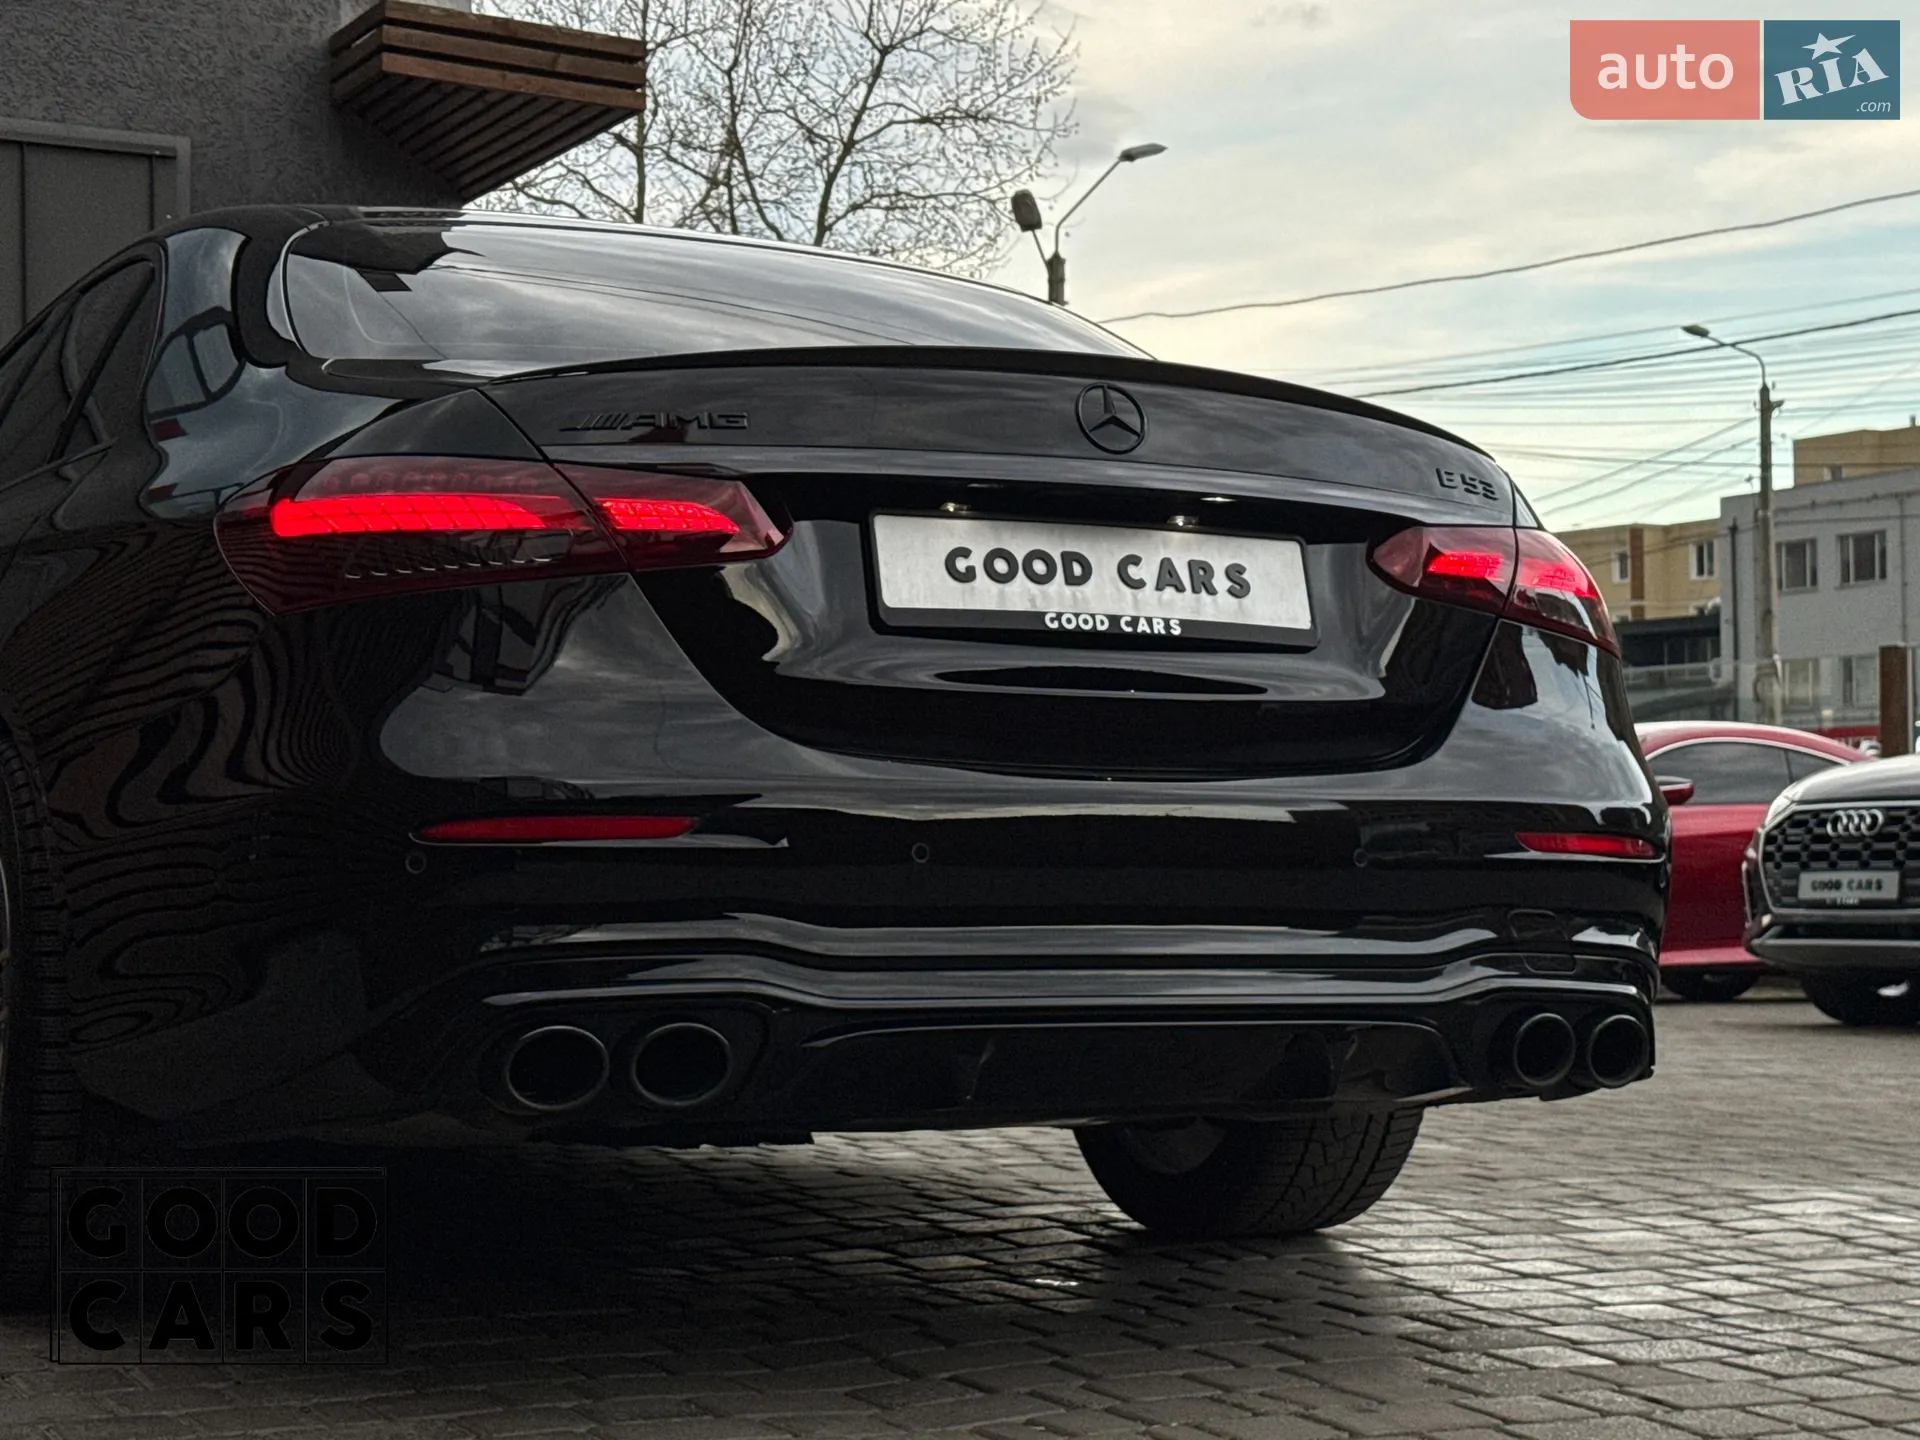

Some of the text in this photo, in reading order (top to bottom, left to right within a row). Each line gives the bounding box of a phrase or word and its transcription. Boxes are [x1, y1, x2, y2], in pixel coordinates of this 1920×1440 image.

[620, 411, 748, 430] AMG
[944, 546, 1252, 599] GOOD CARS
[1045, 612, 1182, 636] GOOD CARS
